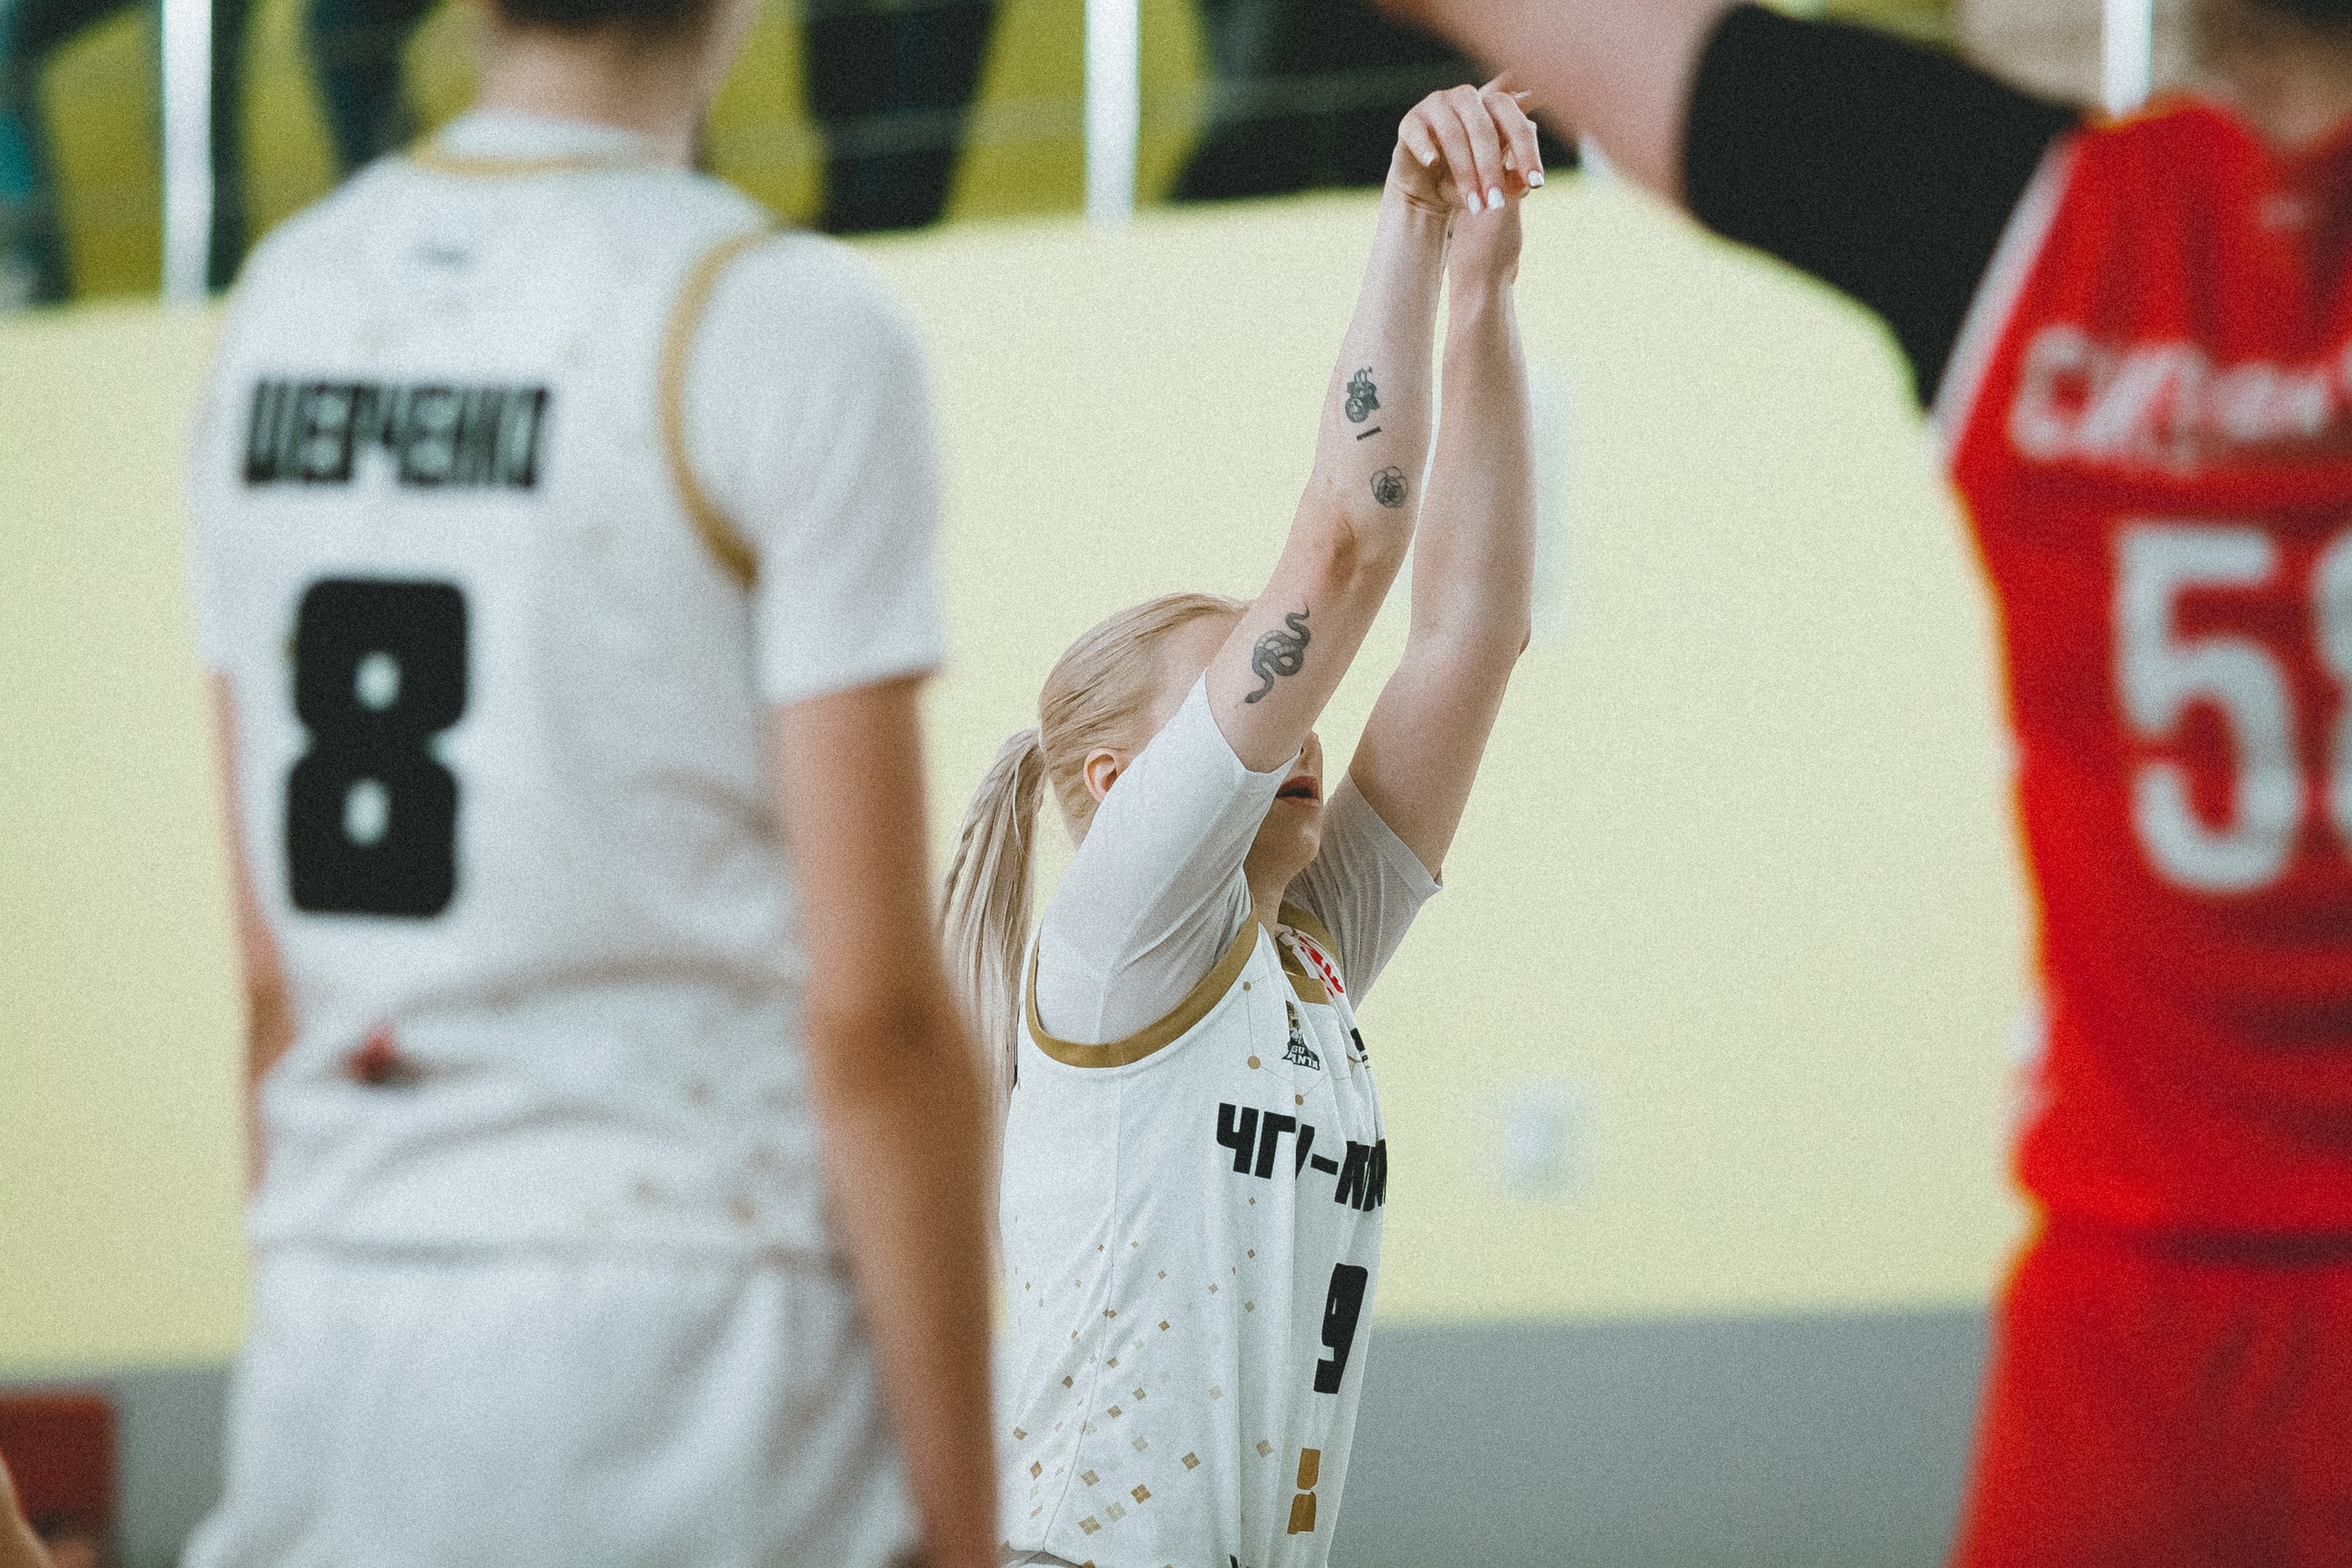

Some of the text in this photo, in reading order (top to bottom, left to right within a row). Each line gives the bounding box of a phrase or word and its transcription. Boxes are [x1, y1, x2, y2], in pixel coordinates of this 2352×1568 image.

[287, 577, 469, 920] 8
[2113, 520, 2352, 889] 5
[1314, 1263, 1368, 1394] 9
